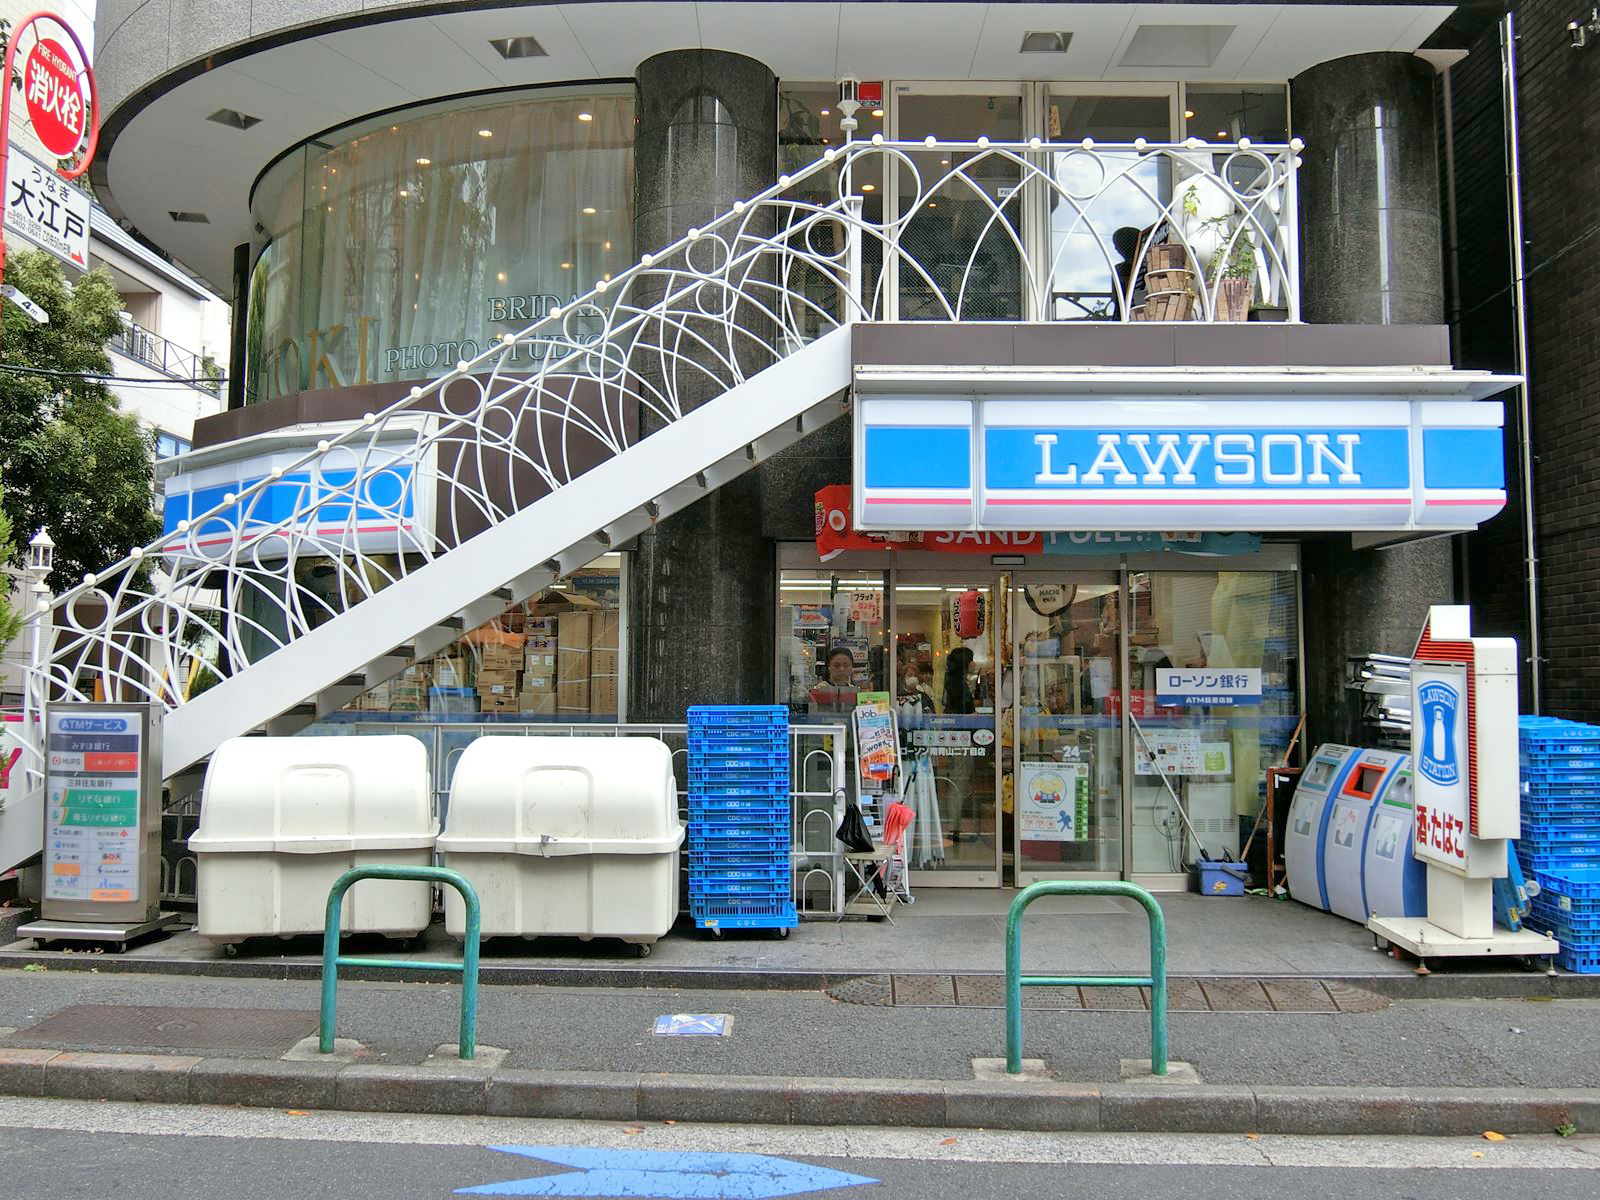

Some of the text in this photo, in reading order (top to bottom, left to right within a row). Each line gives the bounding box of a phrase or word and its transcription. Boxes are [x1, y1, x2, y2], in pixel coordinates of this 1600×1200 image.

[37, 42, 78, 82] FIRE HYDRANT
[29, 58, 81, 134] 消火栓
[31, 165, 71, 203] うなぎ
[11, 178, 85, 238] 大江戸
[22, 301, 38, 316] 4m
[488, 294, 609, 322] BRIDAL
[274, 316, 379, 397] OKI
[385, 334, 607, 373] PHOTO STUDIO
[1033, 433, 1363, 485] LAWSON
[1169, 674, 1249, 689] ローソン銀行
[1421, 687, 1457, 710] LAWSON
[61, 720, 124, 730] ATMサービス
[859, 709, 877, 719] Job
[71, 742, 111, 751] みずほ銀行
[1062, 745, 1081, 758] 24
[62, 758, 81, 766] MUFG
[1422, 756, 1457, 779] STATION
[67, 779, 113, 788] 三井住友銀行
[78, 794, 121, 804] りそな銀行
[1416, 803, 1465, 859] 酒・たばこ
